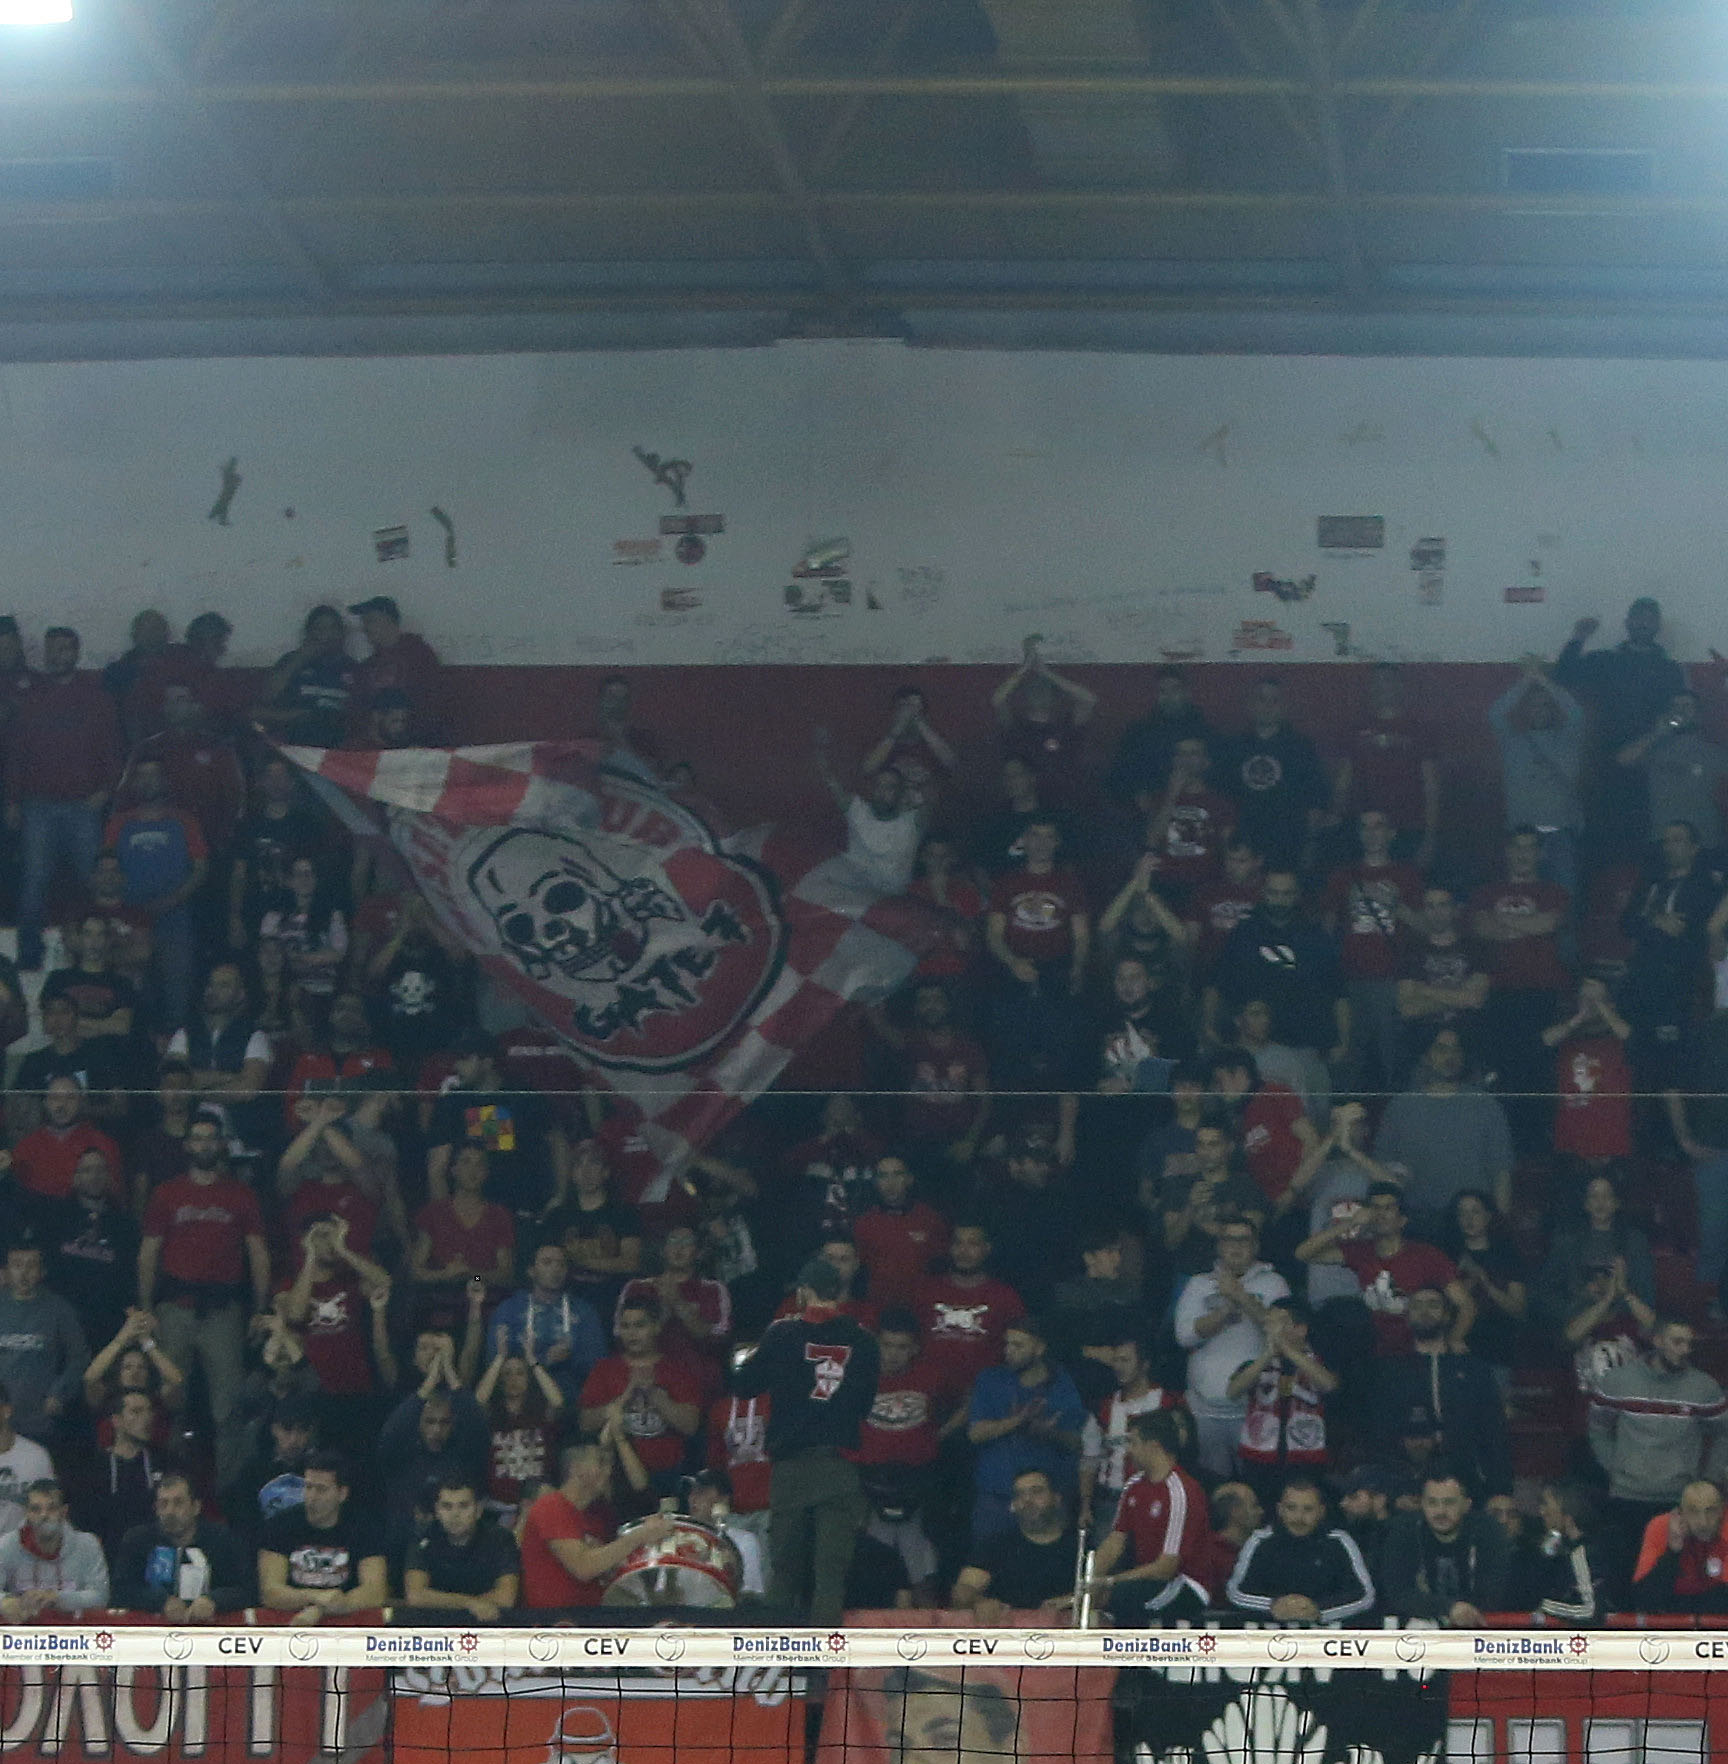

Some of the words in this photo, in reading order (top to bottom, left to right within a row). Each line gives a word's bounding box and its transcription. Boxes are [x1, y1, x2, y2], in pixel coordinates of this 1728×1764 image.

[2, 1635, 89, 1650] DenizBank
[218, 1638, 263, 1654] CEV
[366, 1636, 453, 1651] DenizBank
[584, 1639, 630, 1655] CEV
[733, 1637, 822, 1652] DenizBank
[952, 1640, 998, 1656] CEV
[1103, 1638, 1192, 1653] DenizBank
[1323, 1641, 1369, 1657] CEV
[1473, 1639, 1564, 1654] DenizBank
